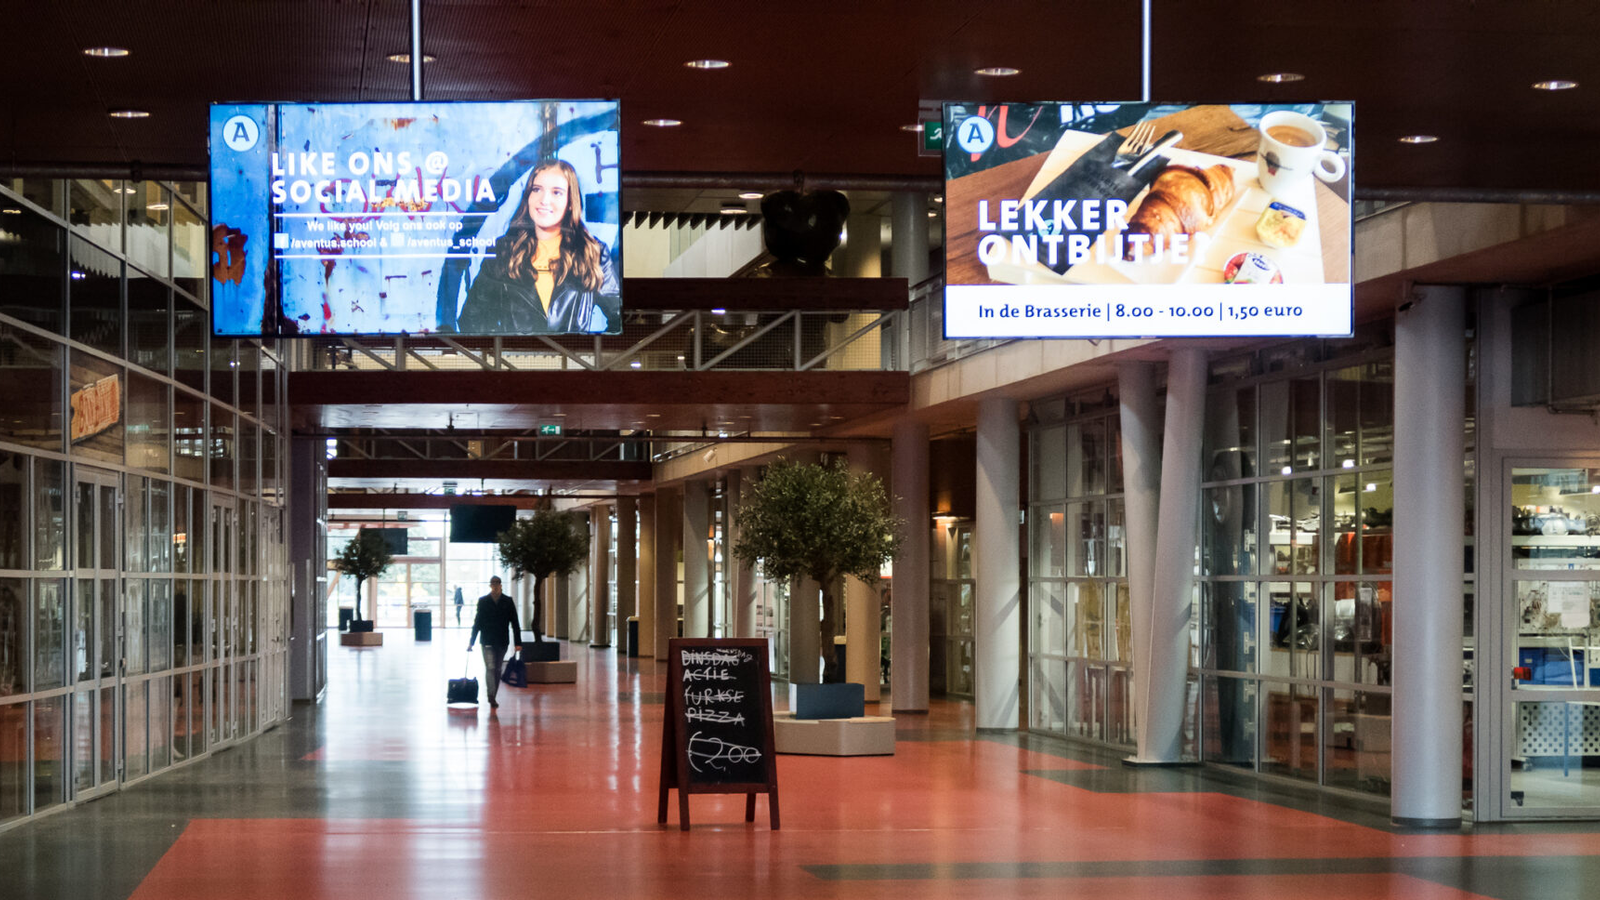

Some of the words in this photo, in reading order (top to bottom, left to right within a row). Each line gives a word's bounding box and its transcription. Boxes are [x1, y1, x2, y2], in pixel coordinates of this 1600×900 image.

[232, 121, 250, 142] A
[966, 122, 985, 143] A
[272, 152, 336, 176] LIKE
[348, 151, 412, 175] ONS
[425, 151, 449, 175] @
[271, 179, 382, 204] SOCIAL
[394, 178, 496, 202] MEDIA
[977, 198, 1129, 231] LEKKER
[306, 220, 325, 231] We
[327, 220, 346, 231] like
[348, 220, 373, 233] you!
[375, 220, 400, 232] Volg
[402, 221, 422, 230] ons
[426, 220, 446, 230] ook
[448, 221, 463, 232] op
[979, 304, 994, 318] In
[999, 303, 1020, 318] de
[1025, 303, 1102, 318] Brasserie
[1115, 303, 1154, 318] 8.00
[1168, 306, 1214, 318] 10.00
[1227, 306, 1259, 320] 1,50
[1264, 306, 1303, 317] euro
